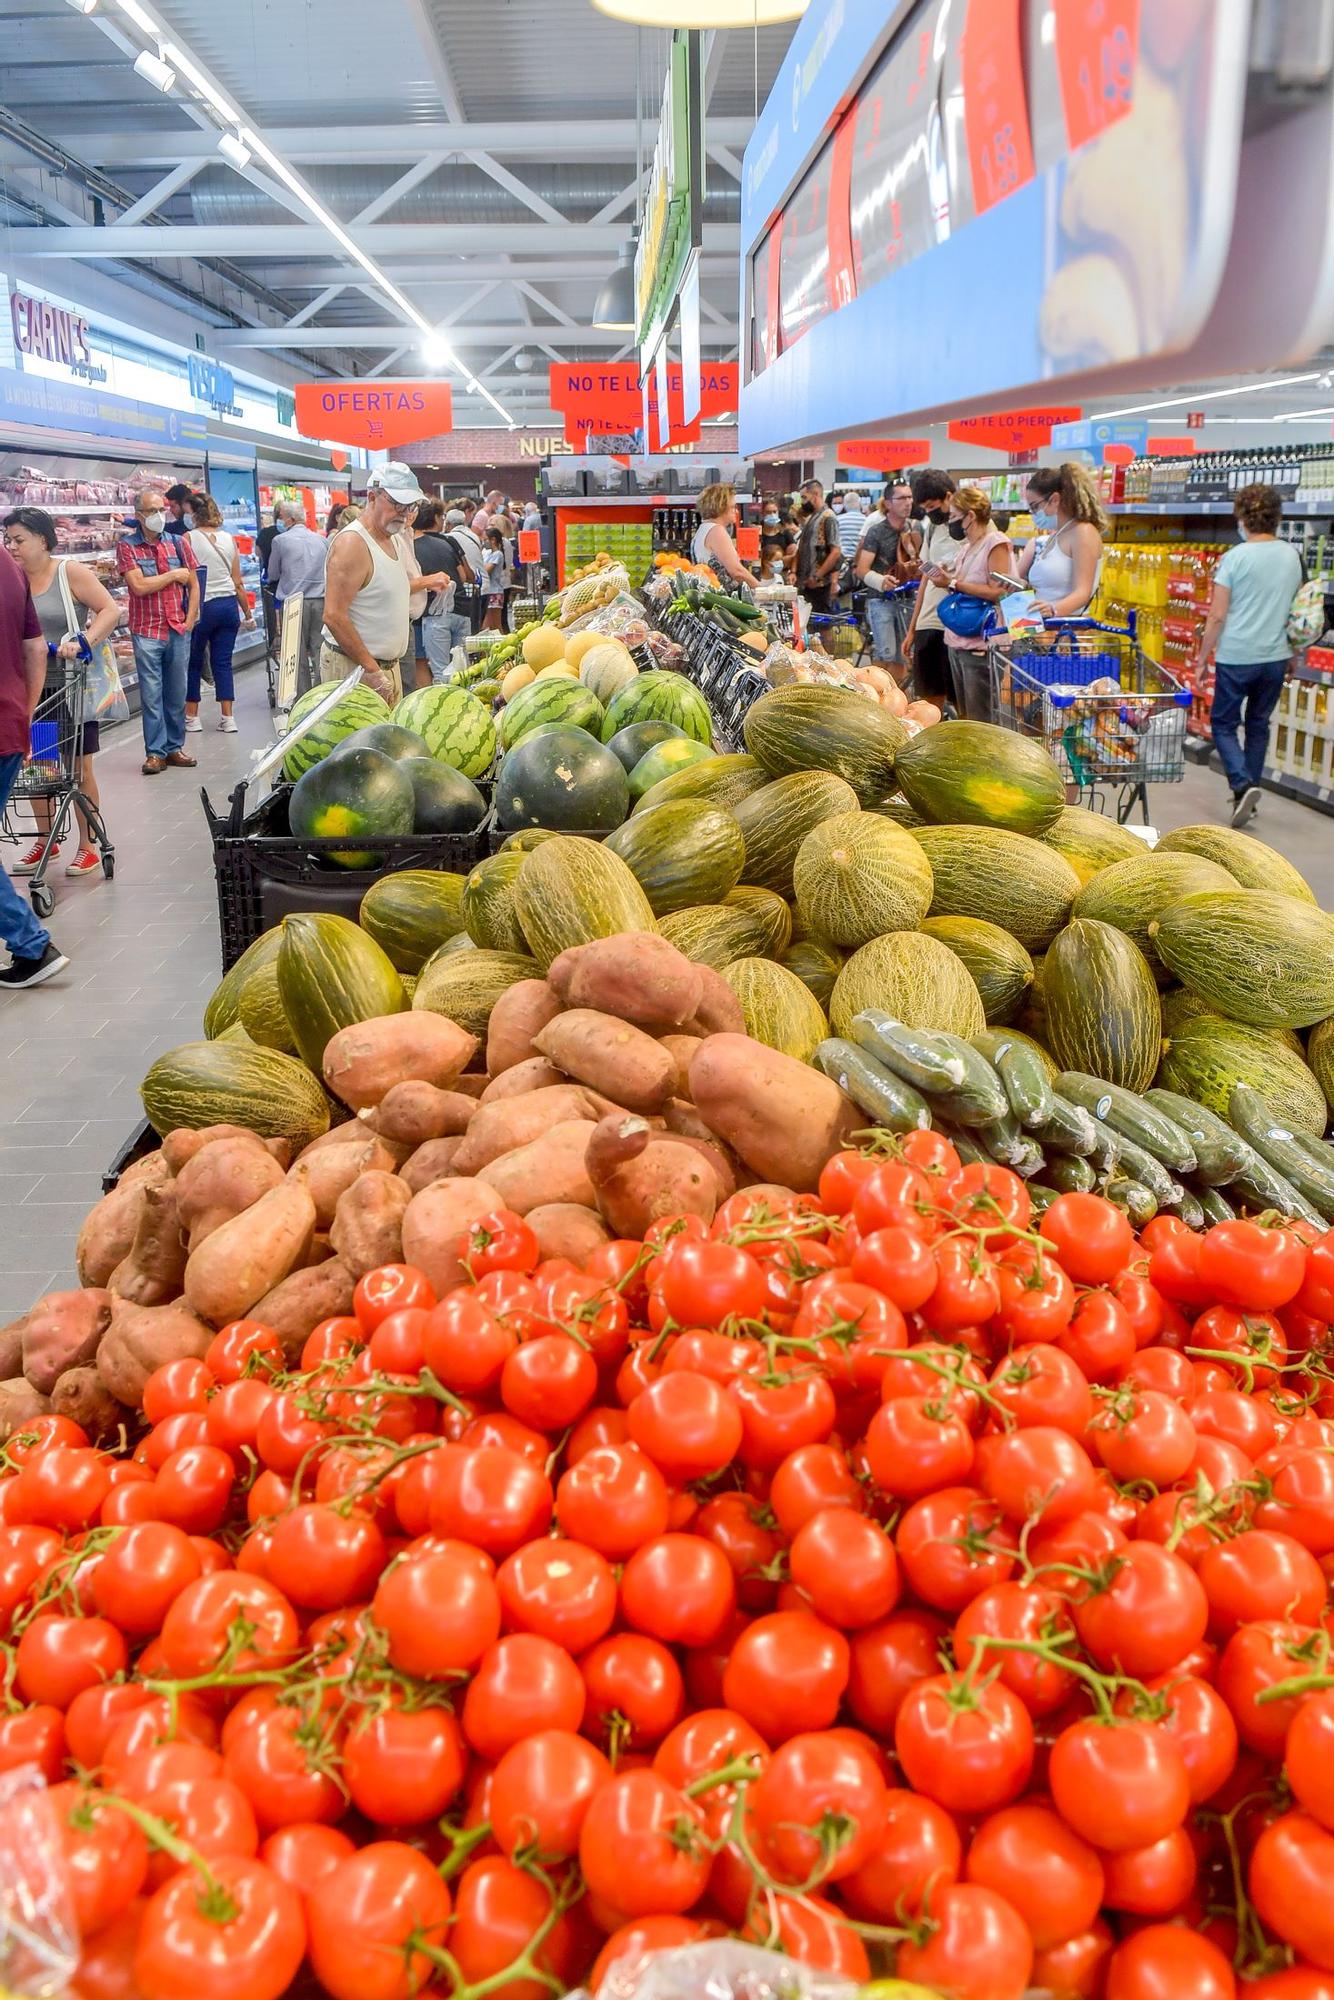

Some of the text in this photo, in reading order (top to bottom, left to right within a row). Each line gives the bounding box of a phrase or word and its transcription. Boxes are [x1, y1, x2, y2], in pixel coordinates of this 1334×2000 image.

[11, 292, 91, 367] CARNES
[568, 376, 593, 392] NO
[598, 376, 620, 391] TE
[321, 391, 425, 412] OFERTAS
[576, 419, 594, 429] NO
[981, 416, 993, 427] TE
[999, 416, 1014, 427] LO
